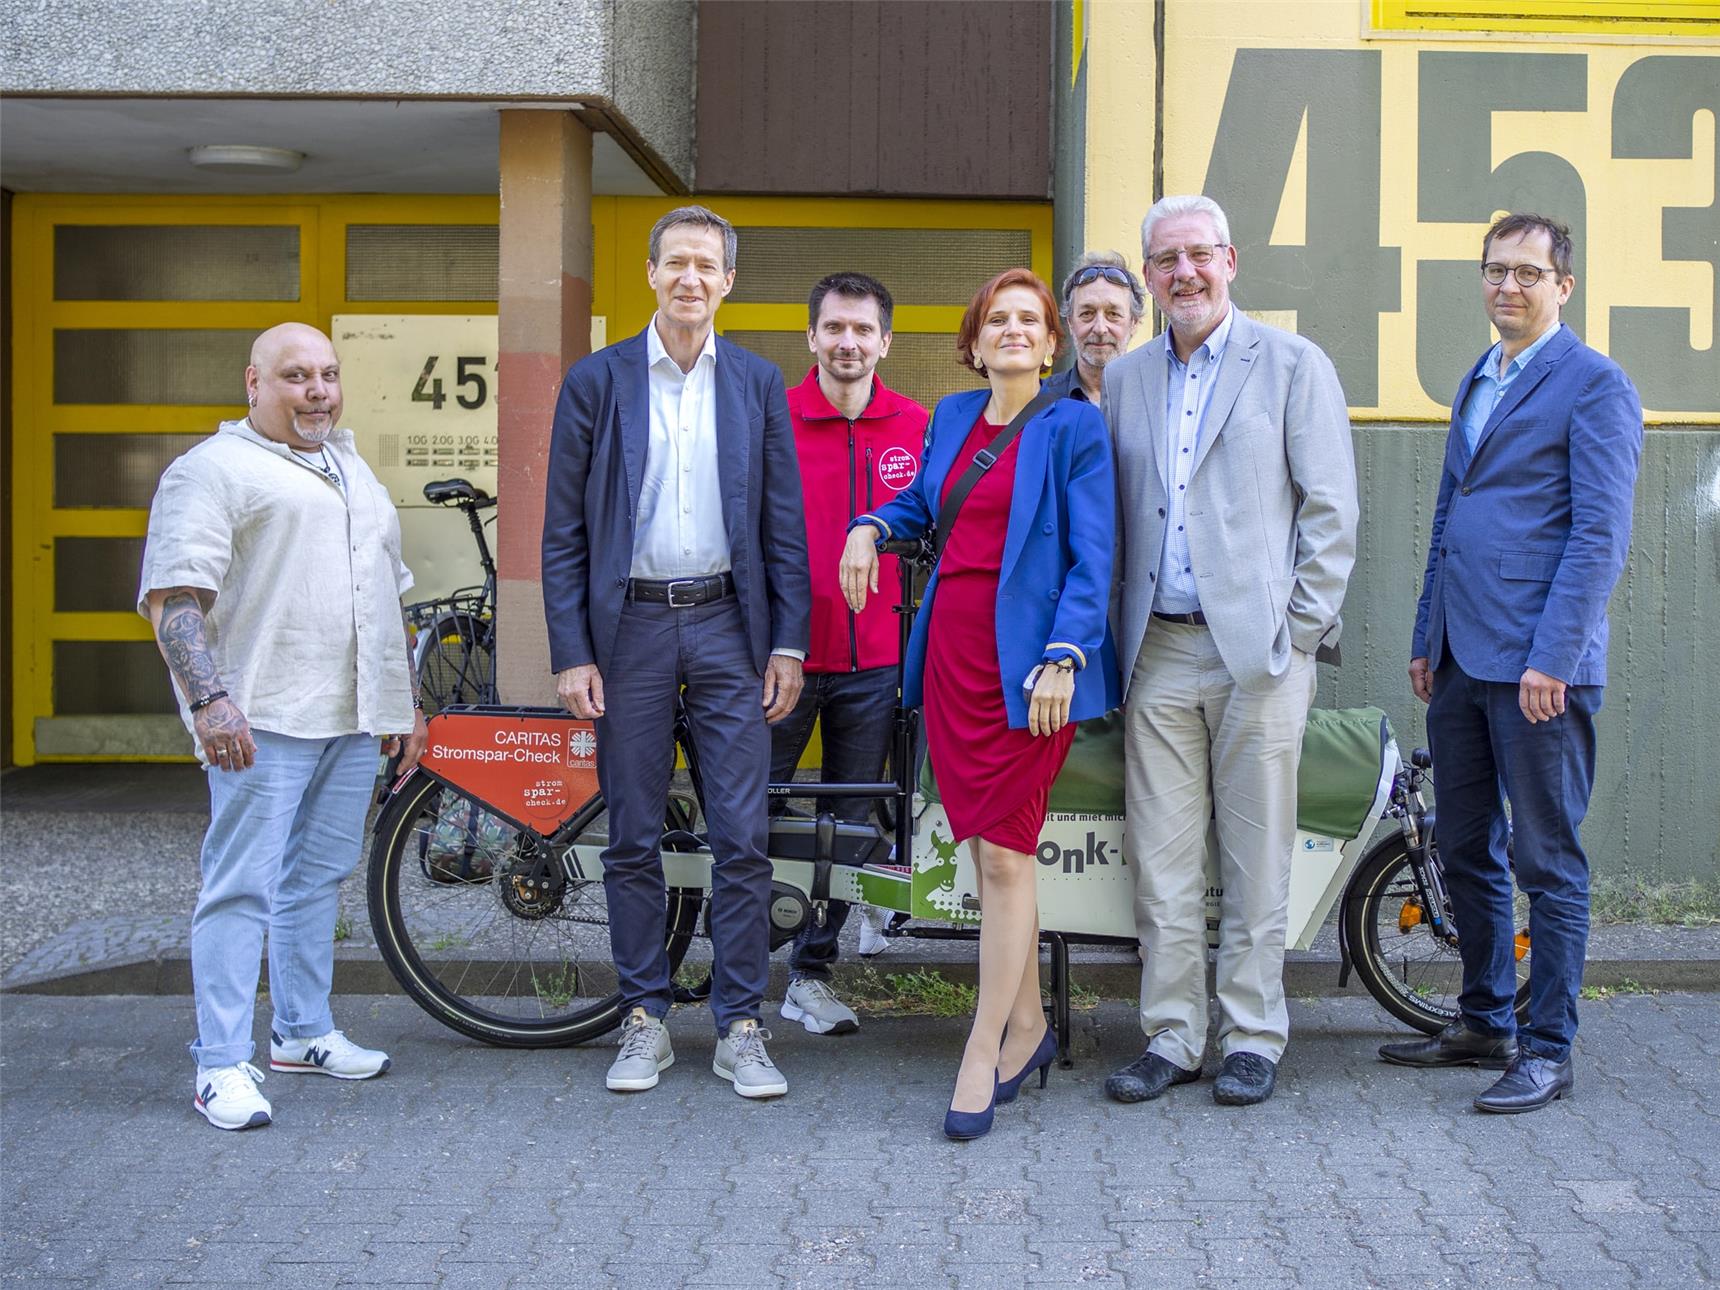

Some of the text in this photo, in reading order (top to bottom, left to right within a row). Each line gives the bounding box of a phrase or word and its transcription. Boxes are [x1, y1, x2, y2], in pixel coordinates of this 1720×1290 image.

[411, 356, 498, 410] 45
[881, 463, 910, 472] spar-
[883, 471, 914, 479] check.de
[494, 730, 561, 747] CARITAS
[432, 744, 561, 763] Stromspar-Check
[523, 788, 562, 799] spar-
[525, 798, 567, 807] check.de
[1057, 812, 1076, 822] und
[1036, 831, 1127, 874] onk-
